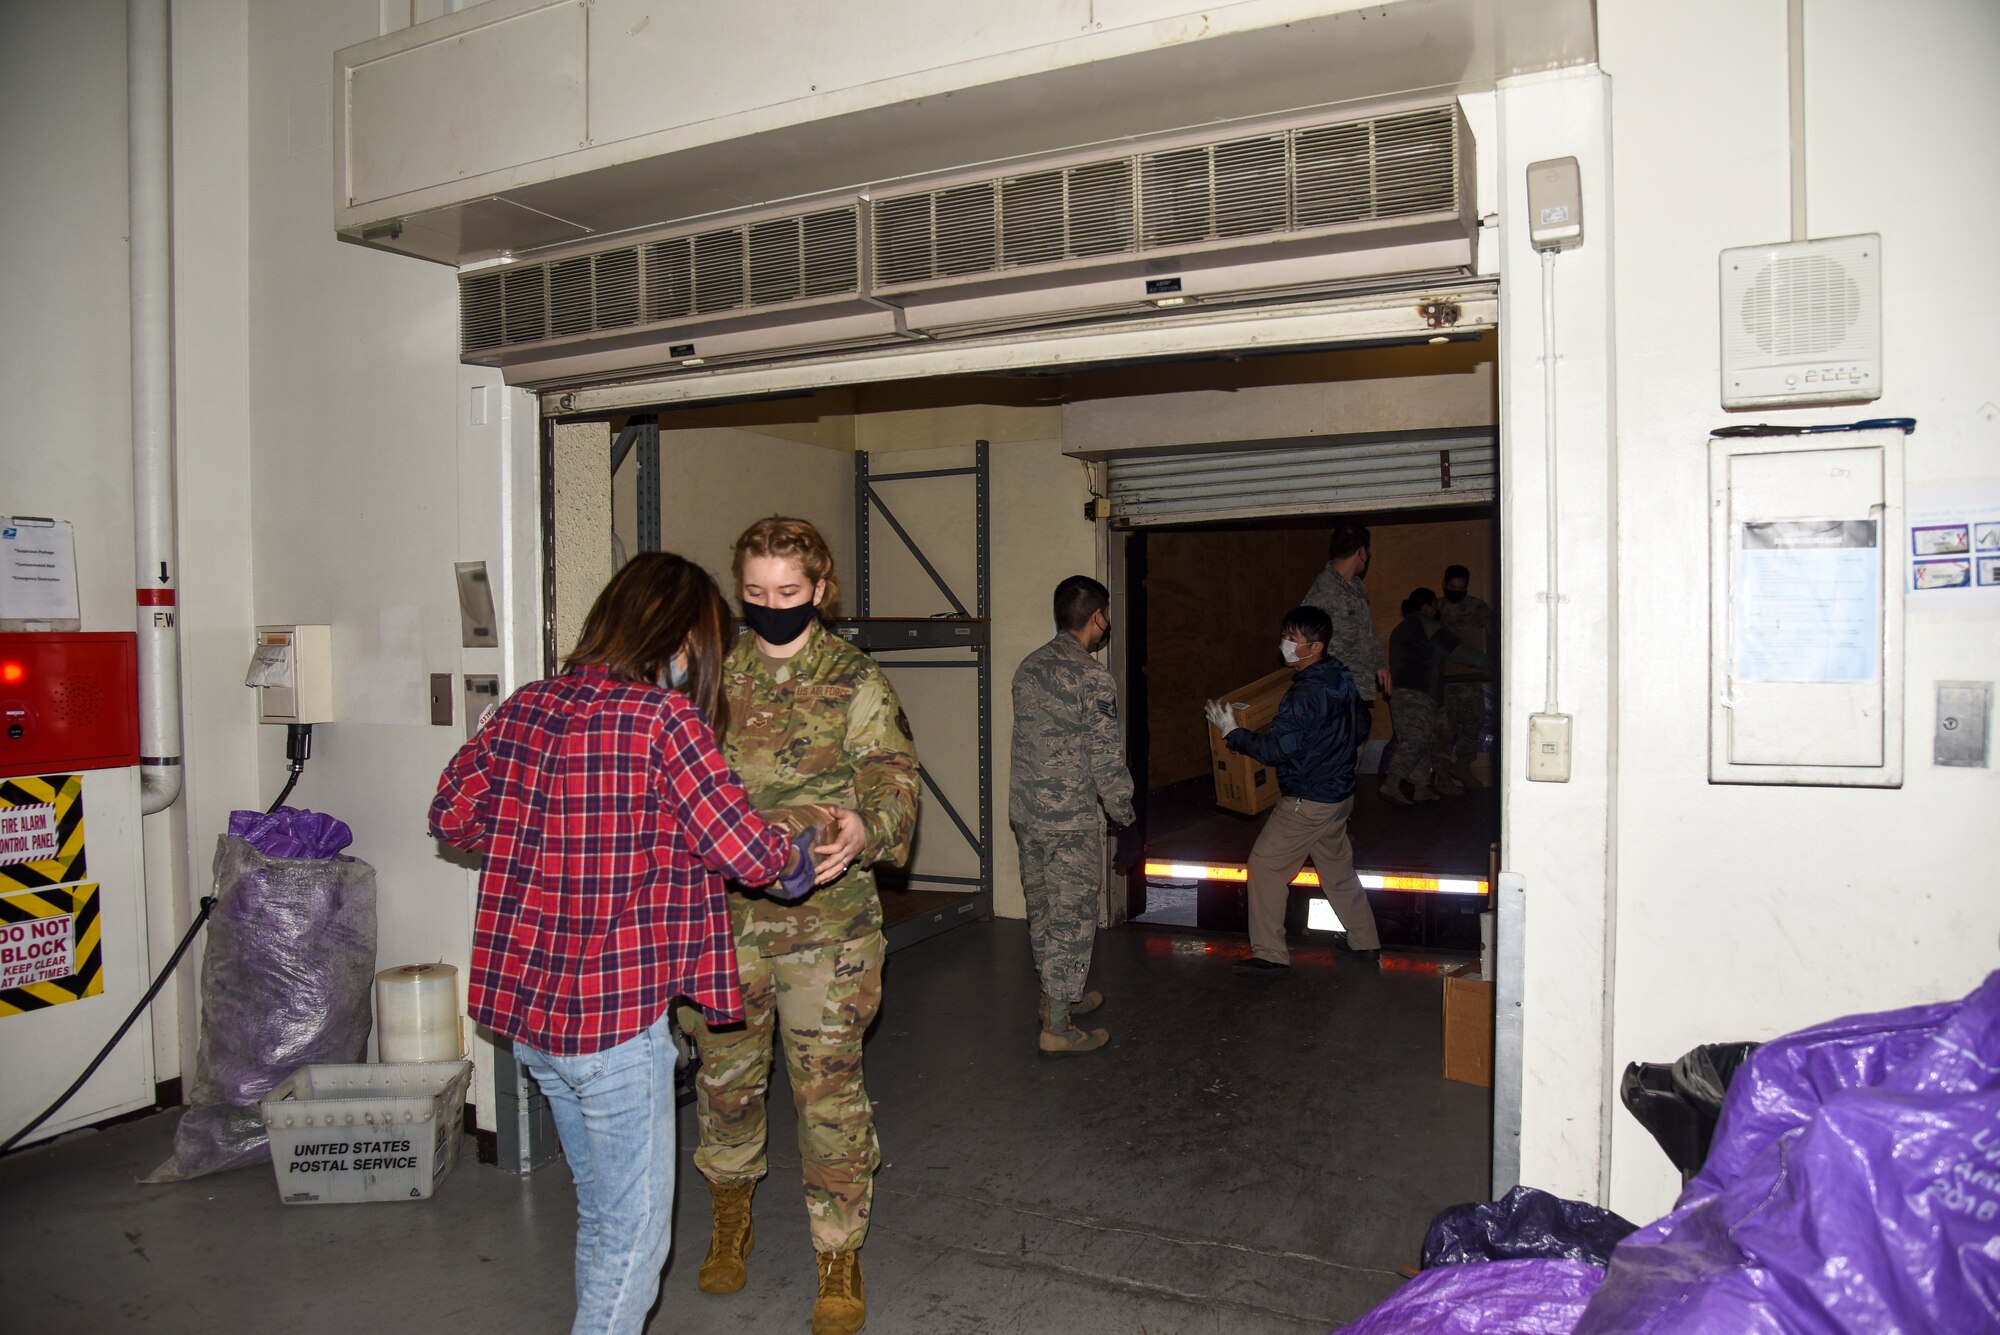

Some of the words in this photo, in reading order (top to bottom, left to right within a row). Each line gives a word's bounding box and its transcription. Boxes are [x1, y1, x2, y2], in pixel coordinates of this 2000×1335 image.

[796, 687, 808, 696] US
[810, 686, 823, 696] AIR
[1, 817, 19, 834] FIRE
[20, 814, 47, 831] ALARM
[0, 836, 29, 854] ONTROL
[31, 833, 54, 850] PANEL
[31, 918, 70, 939] NOT
[1, 937, 68, 964] BLOCK
[3, 963, 32, 976] KEEP
[34, 955, 66, 970] CLEAR
[1, 977, 15, 988] AT
[17, 973, 36, 985] ALL
[38, 966, 70, 979] TIMES
[294, 1143, 349, 1156] UNITED
[352, 1140, 411, 1154] STATES
[289, 1160, 349, 1173] POSTAL
[353, 1157, 418, 1170] SERVICE
